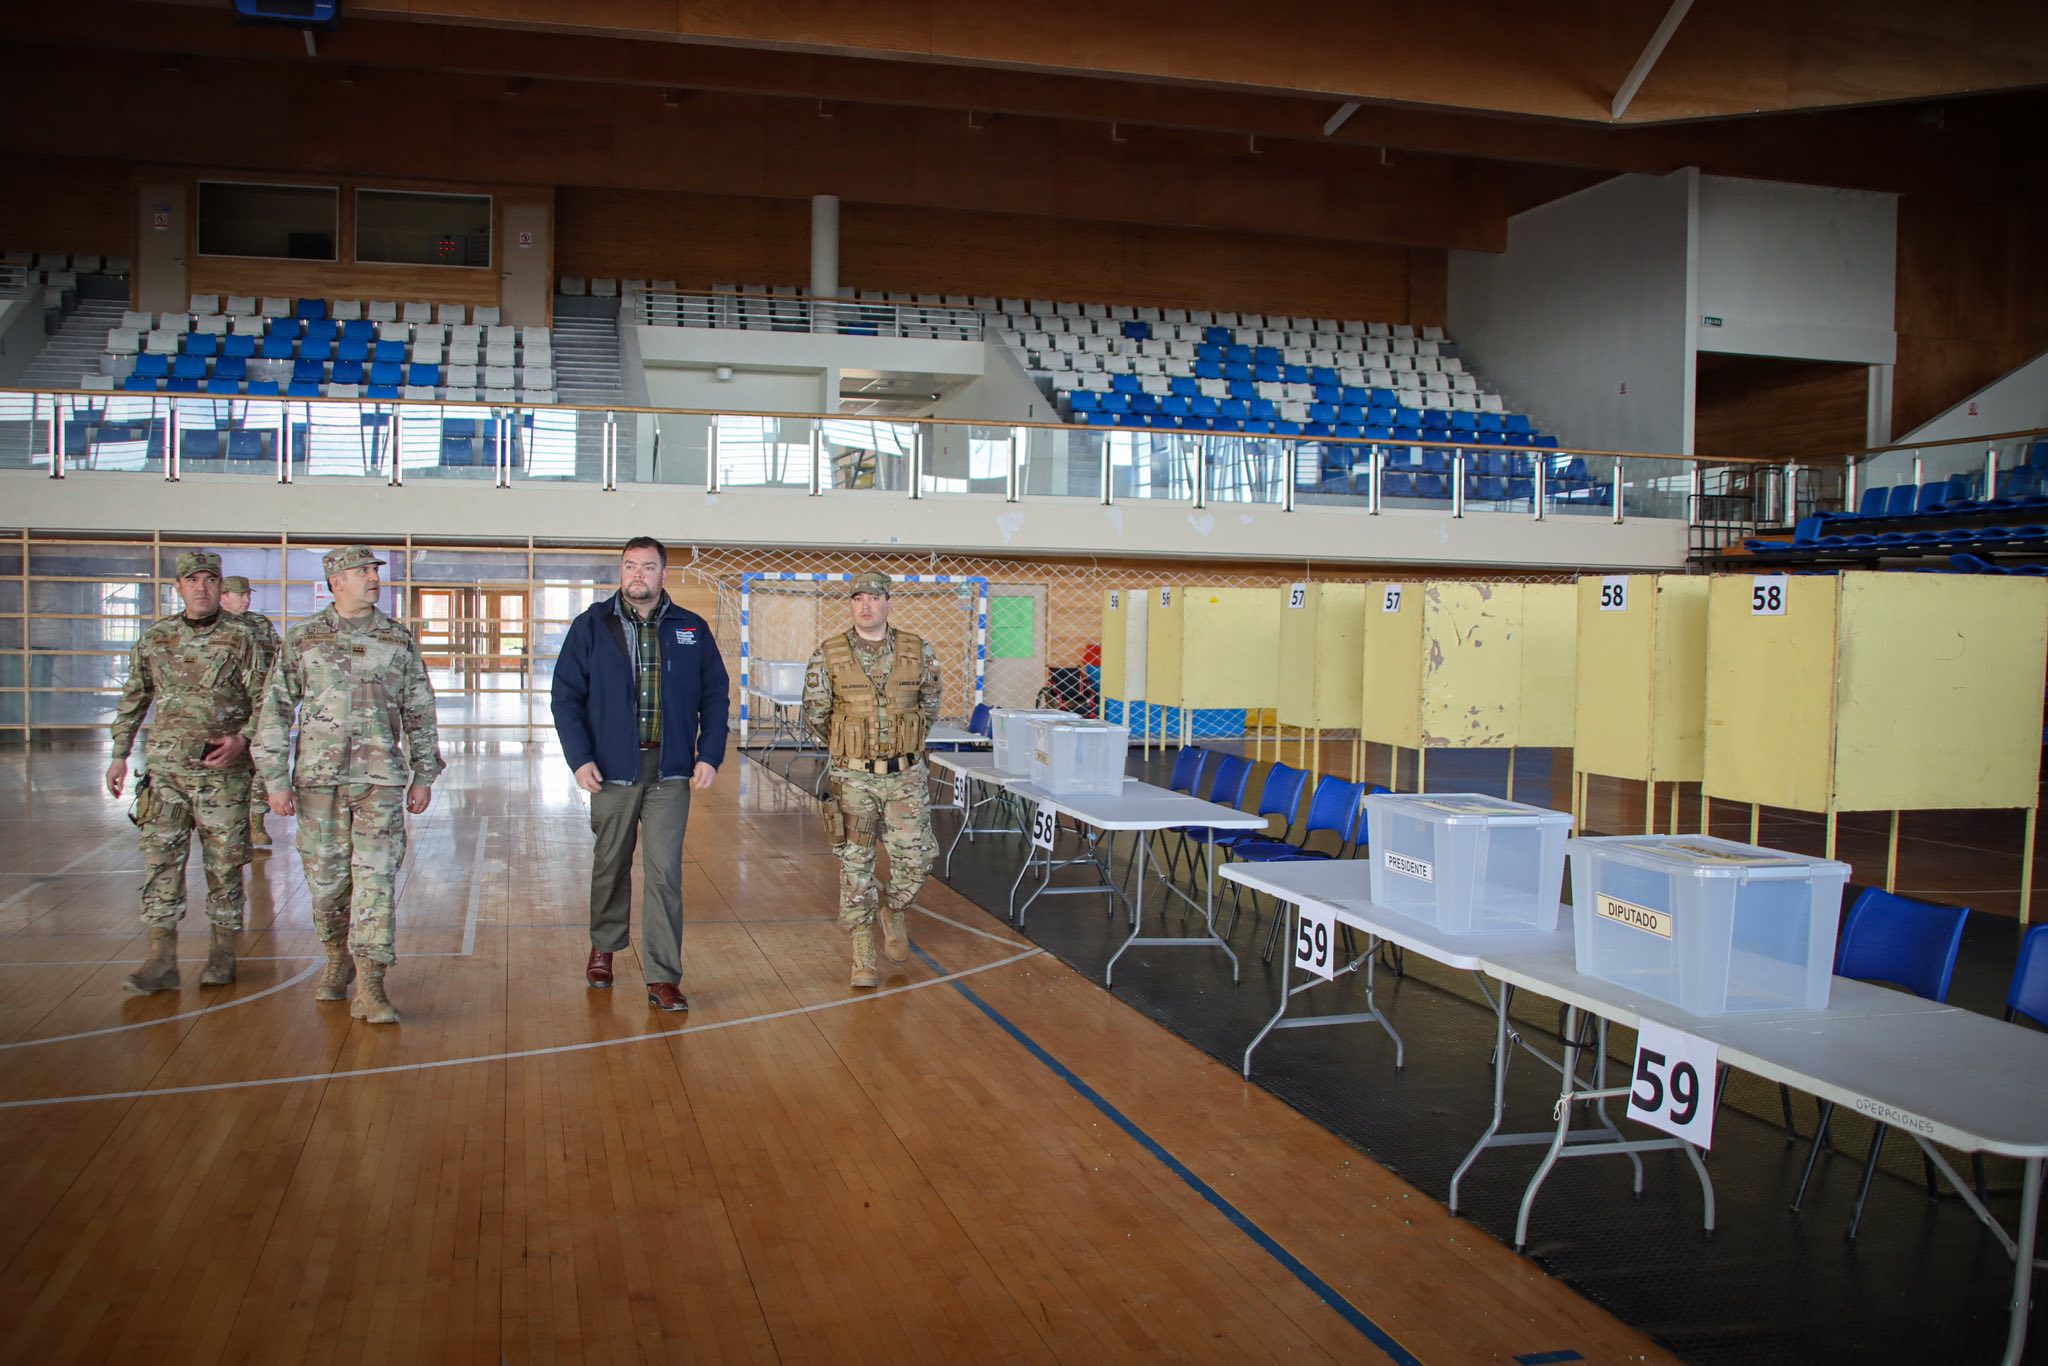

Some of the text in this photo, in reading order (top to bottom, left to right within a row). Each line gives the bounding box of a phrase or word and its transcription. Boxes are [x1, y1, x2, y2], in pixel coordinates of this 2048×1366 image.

[1111, 595, 1119, 608] 56
[1162, 592, 1171, 606] 56
[1291, 589, 1305, 606] 57
[1386, 592, 1401, 610] 57
[1601, 584, 1624, 607] 58
[1752, 585, 1781, 611] 58
[954, 777, 964, 802] 58
[1033, 810, 1053, 844] 58
[1388, 855, 1428, 878] PRESIDENTE
[1607, 901, 1658, 930] DIPUTADO
[1297, 916, 1328, 968] 59
[1631, 1046, 1699, 1126] 59
[1855, 1097, 1935, 1134] OPERACIONES
